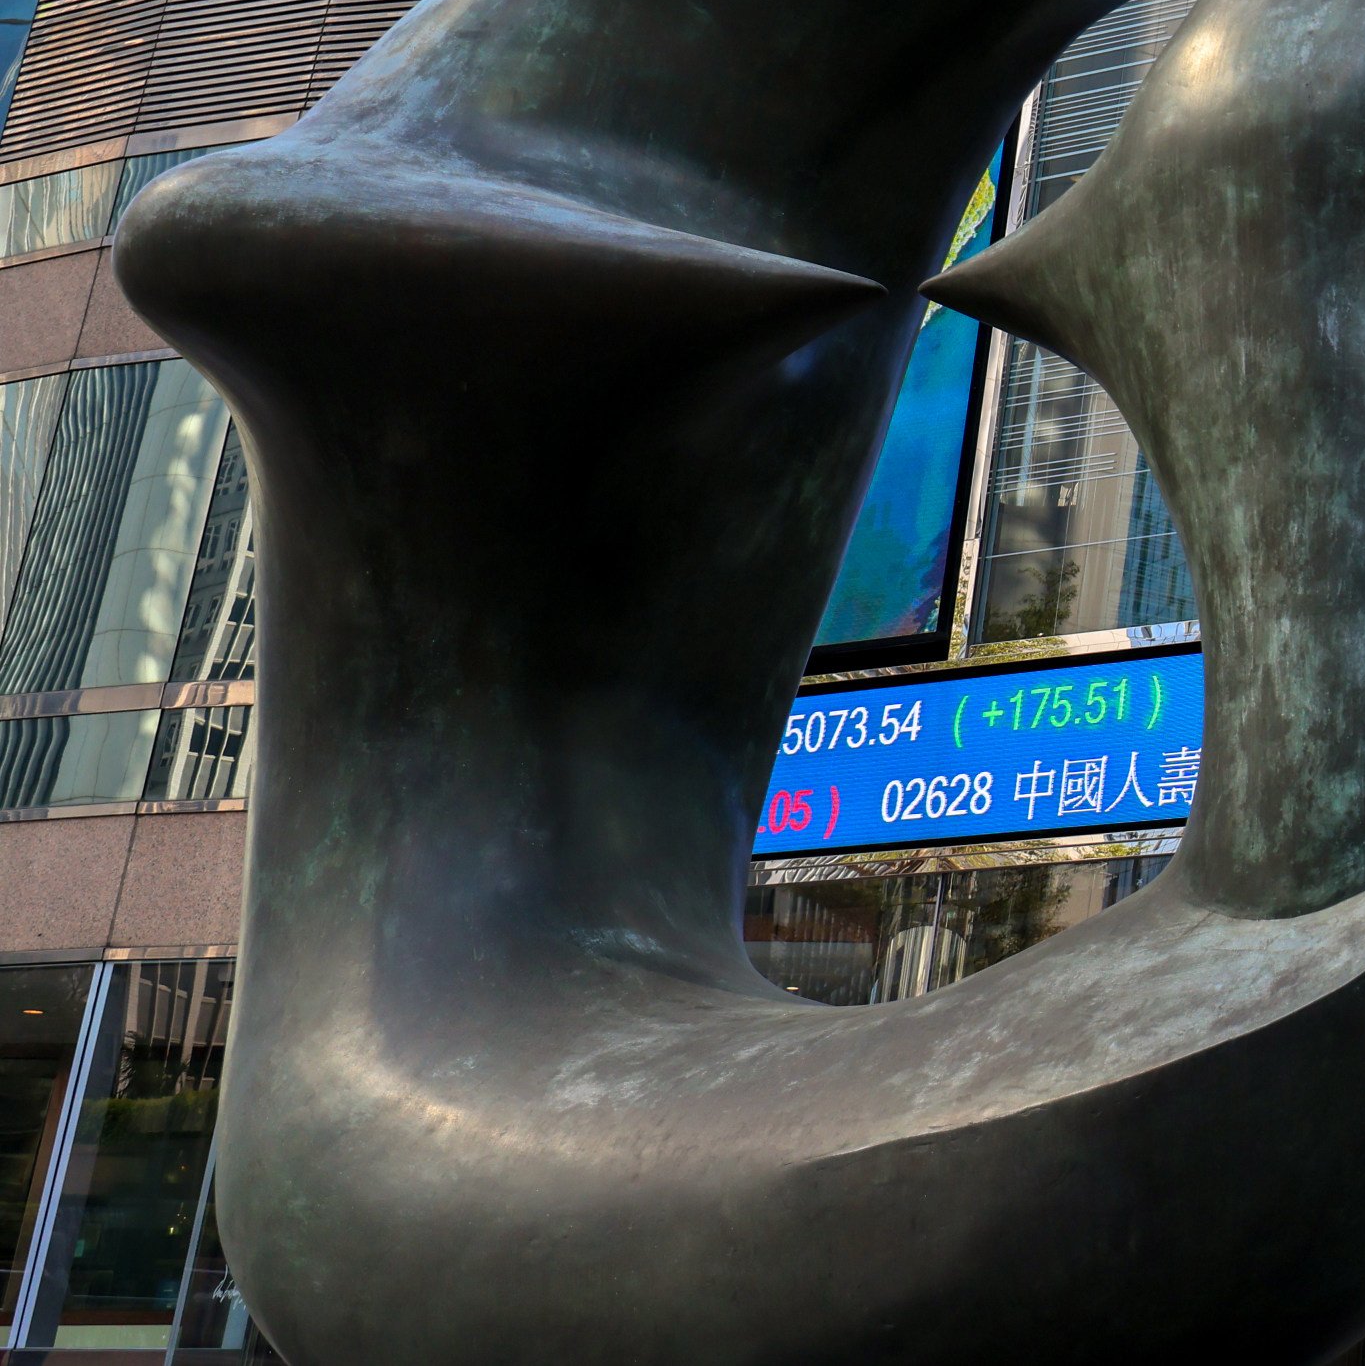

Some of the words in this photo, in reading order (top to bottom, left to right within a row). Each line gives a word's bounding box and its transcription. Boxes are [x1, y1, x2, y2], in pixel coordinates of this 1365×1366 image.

[777, 700, 922, 754] 5073.54
[881, 772, 993, 822] 02628
[1013, 746, 1202, 820] 中國人壽
